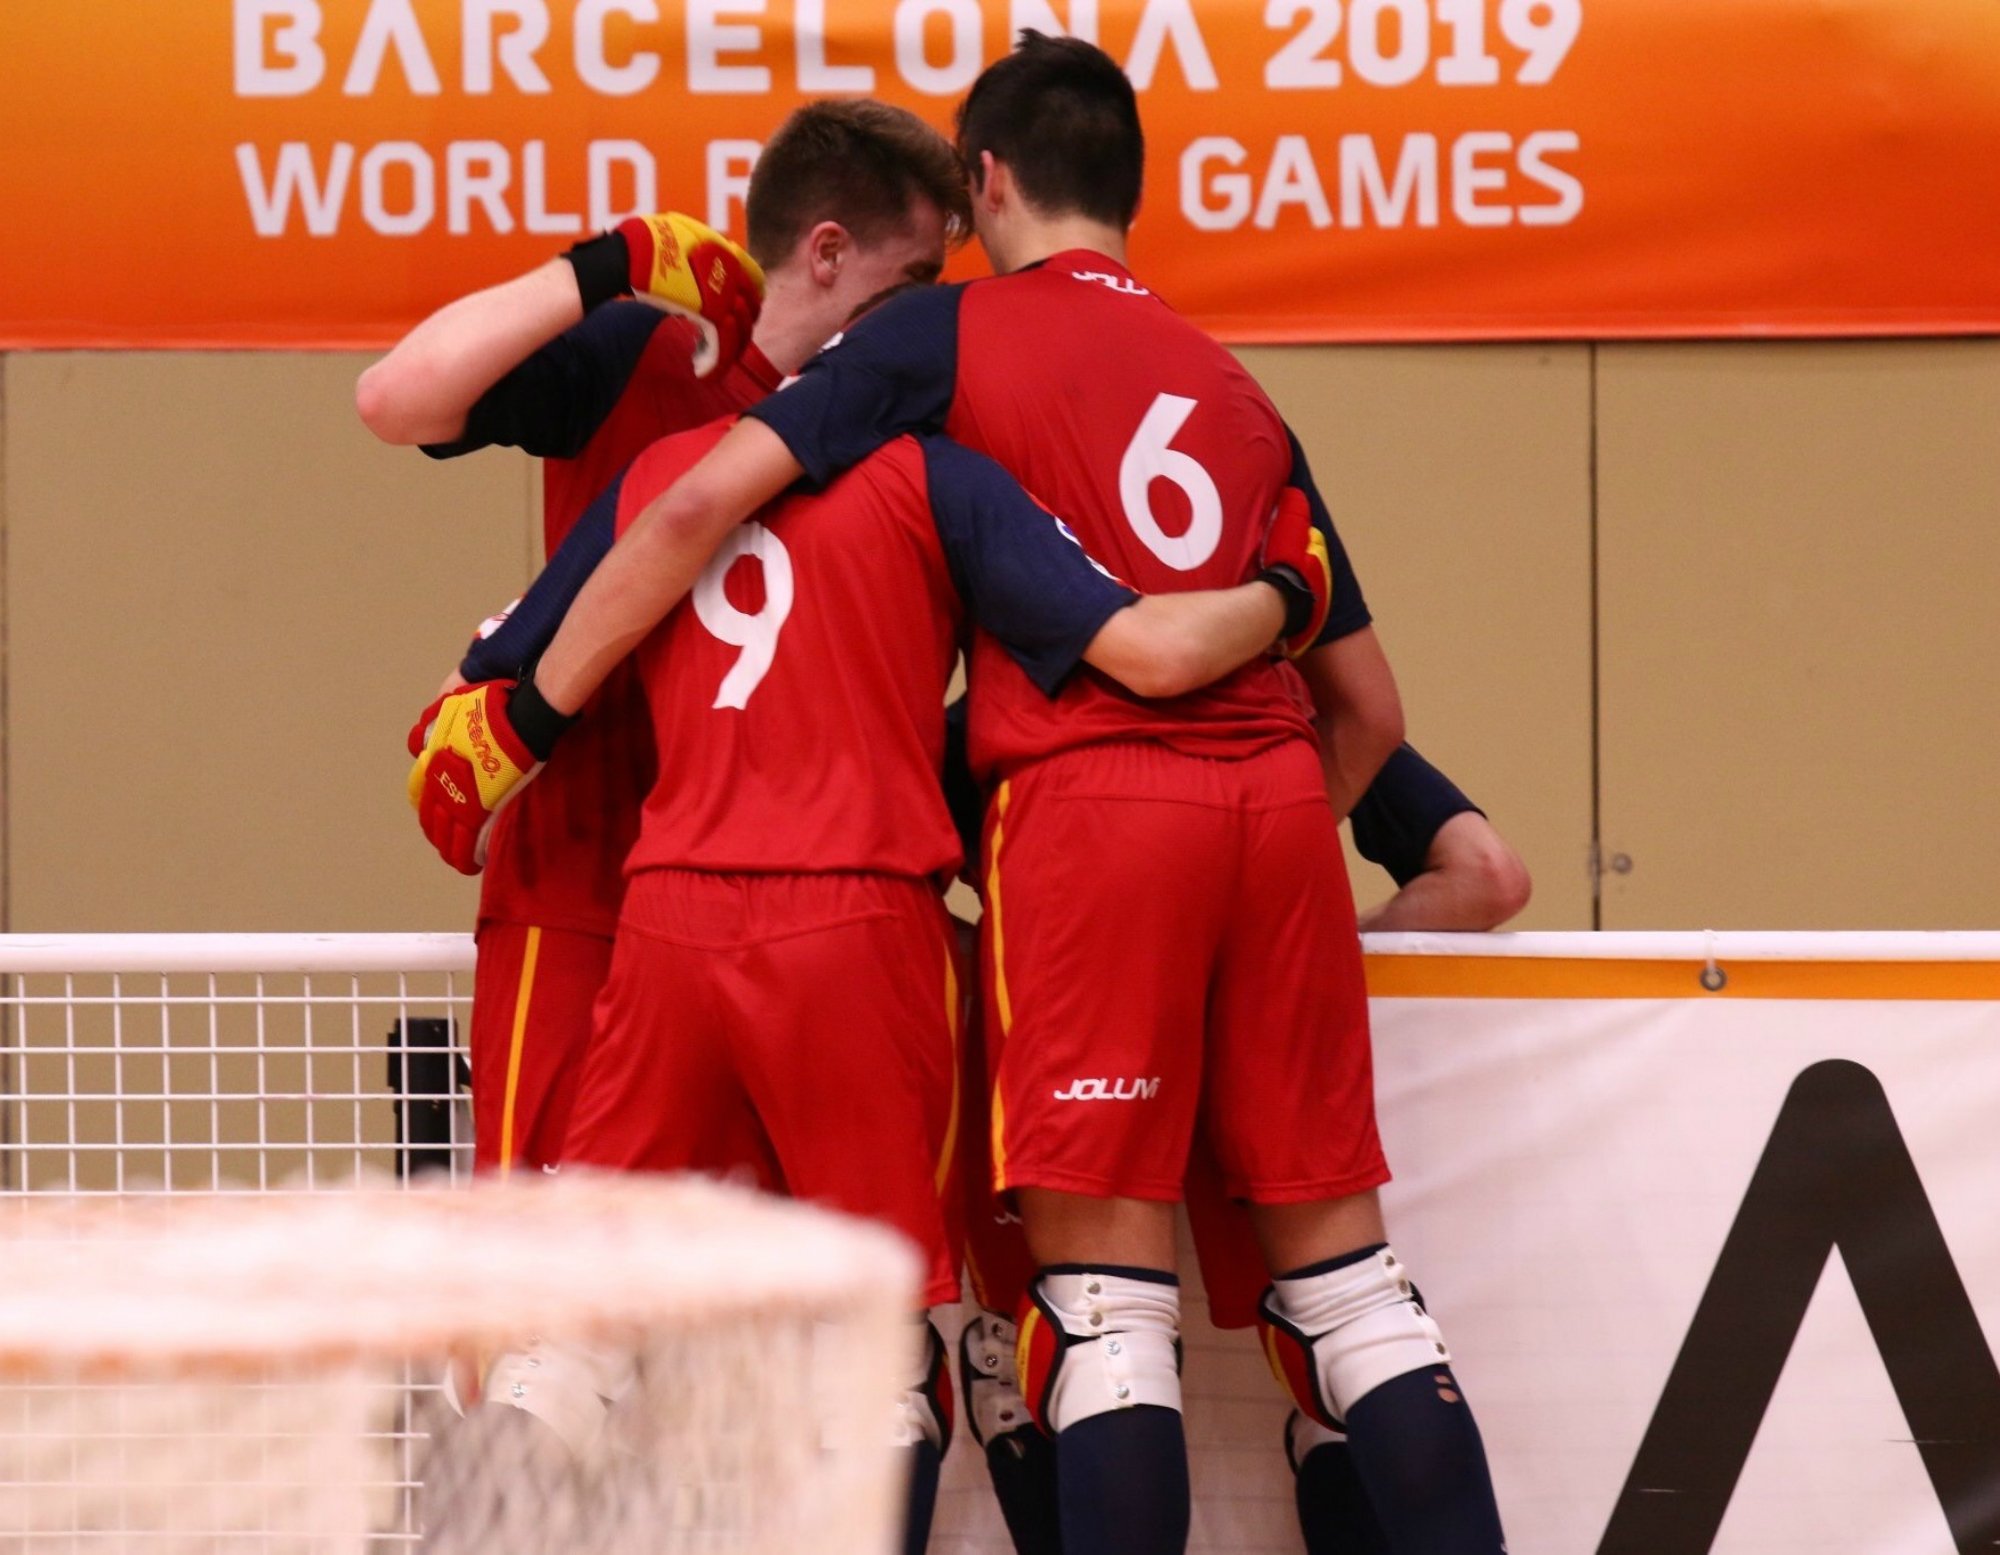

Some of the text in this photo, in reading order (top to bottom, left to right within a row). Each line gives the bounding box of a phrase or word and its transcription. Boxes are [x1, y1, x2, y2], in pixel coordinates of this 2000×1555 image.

[1263, 0, 1585, 90] 2019
[235, 139, 657, 236] WORLD
[1179, 131, 1585, 231] GAMES
[1118, 391, 1223, 572] 6
[691, 519, 795, 711] 9
[433, 770, 467, 804] ESP
